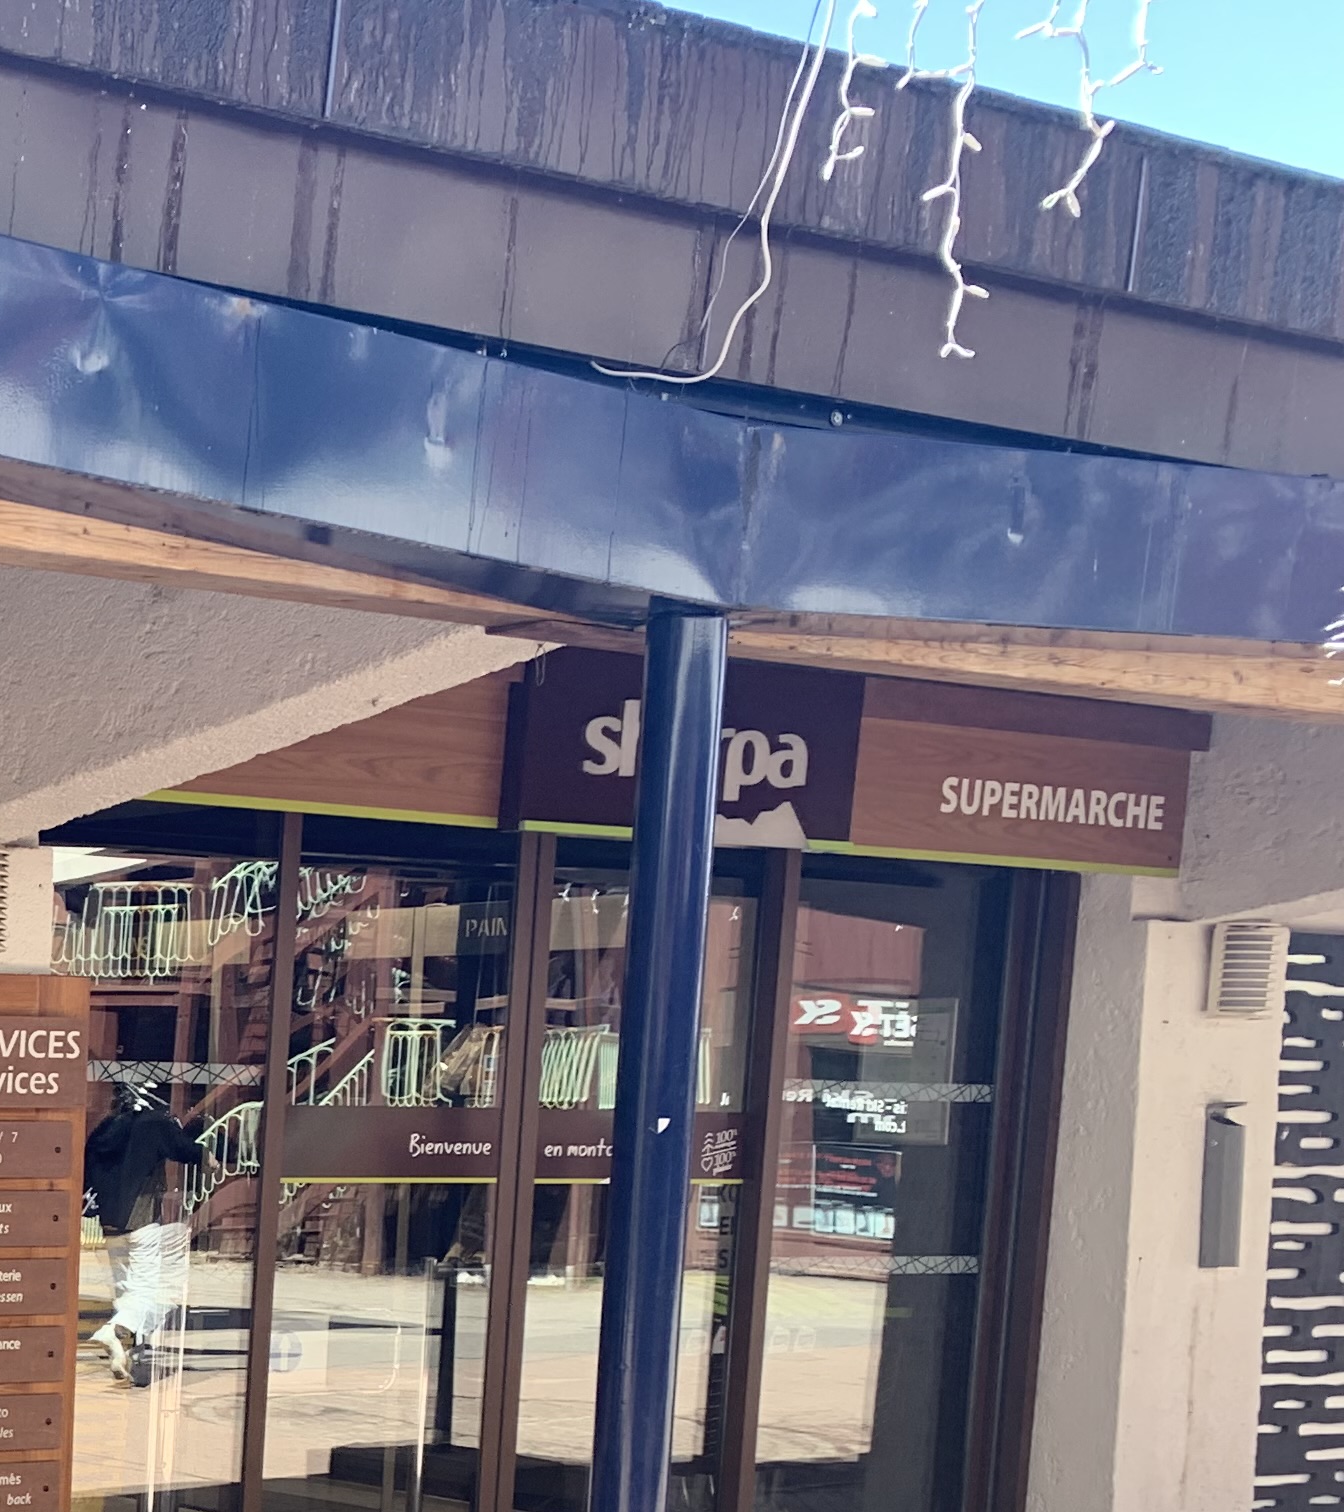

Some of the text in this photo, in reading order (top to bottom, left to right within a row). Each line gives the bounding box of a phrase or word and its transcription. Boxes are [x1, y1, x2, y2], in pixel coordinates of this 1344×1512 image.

[582, 699, 809, 802] spa
[939, 776, 1166, 831] SUPERMARCHE
[11, 1131, 19, 1143] 7
[408, 1133, 492, 1158] Bienvenue
[543, 1145, 563, 1158] en
[6, 1493, 32, 1506] back
